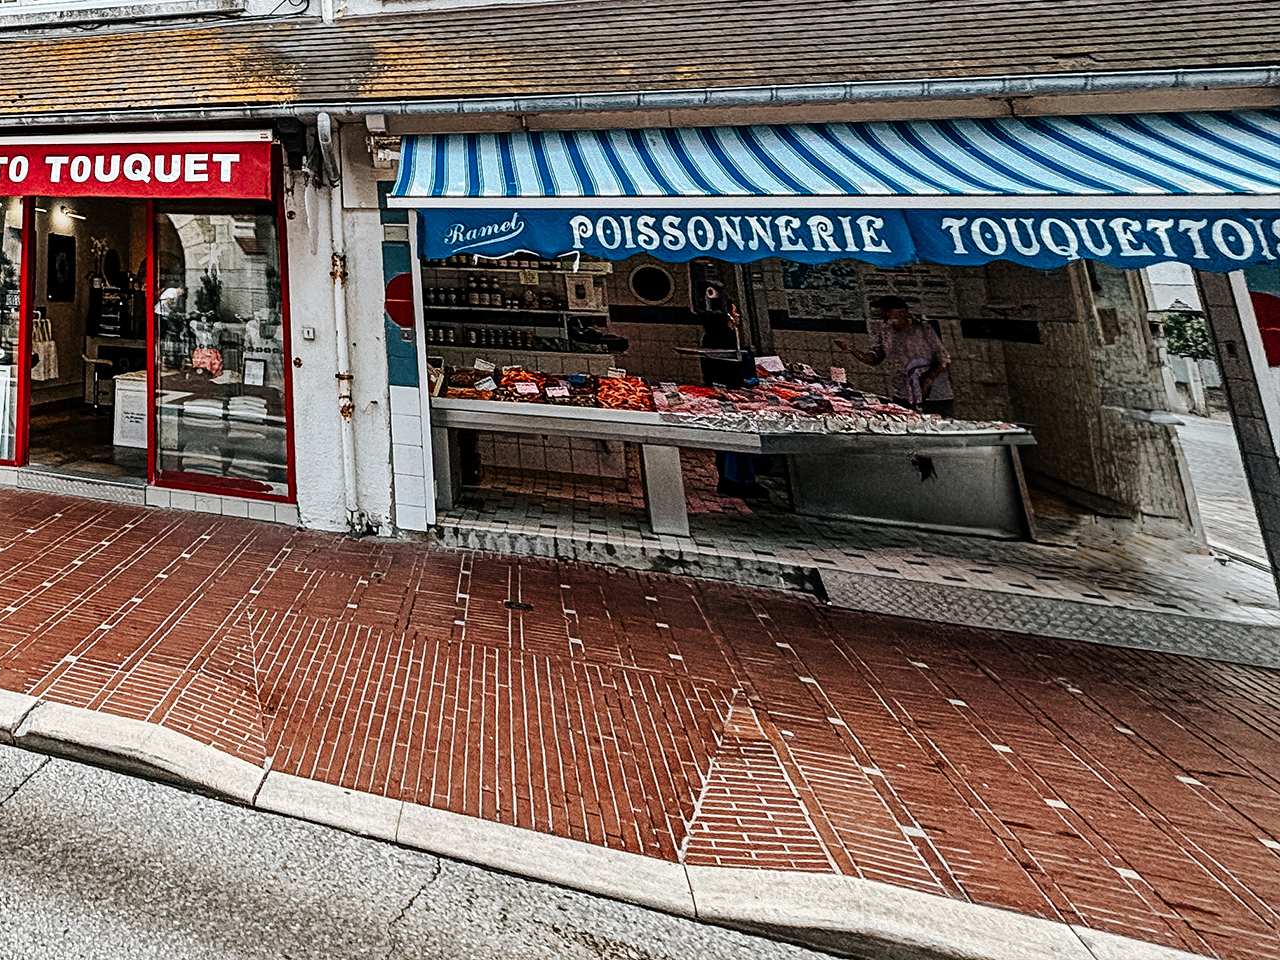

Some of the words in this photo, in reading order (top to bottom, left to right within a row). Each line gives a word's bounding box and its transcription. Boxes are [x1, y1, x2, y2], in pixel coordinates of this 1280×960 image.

[45, 152, 240, 184] TOUQUET
[570, 215, 891, 253] POISSONNERIE
[941, 217, 1280, 260] TOUQUETTOI
